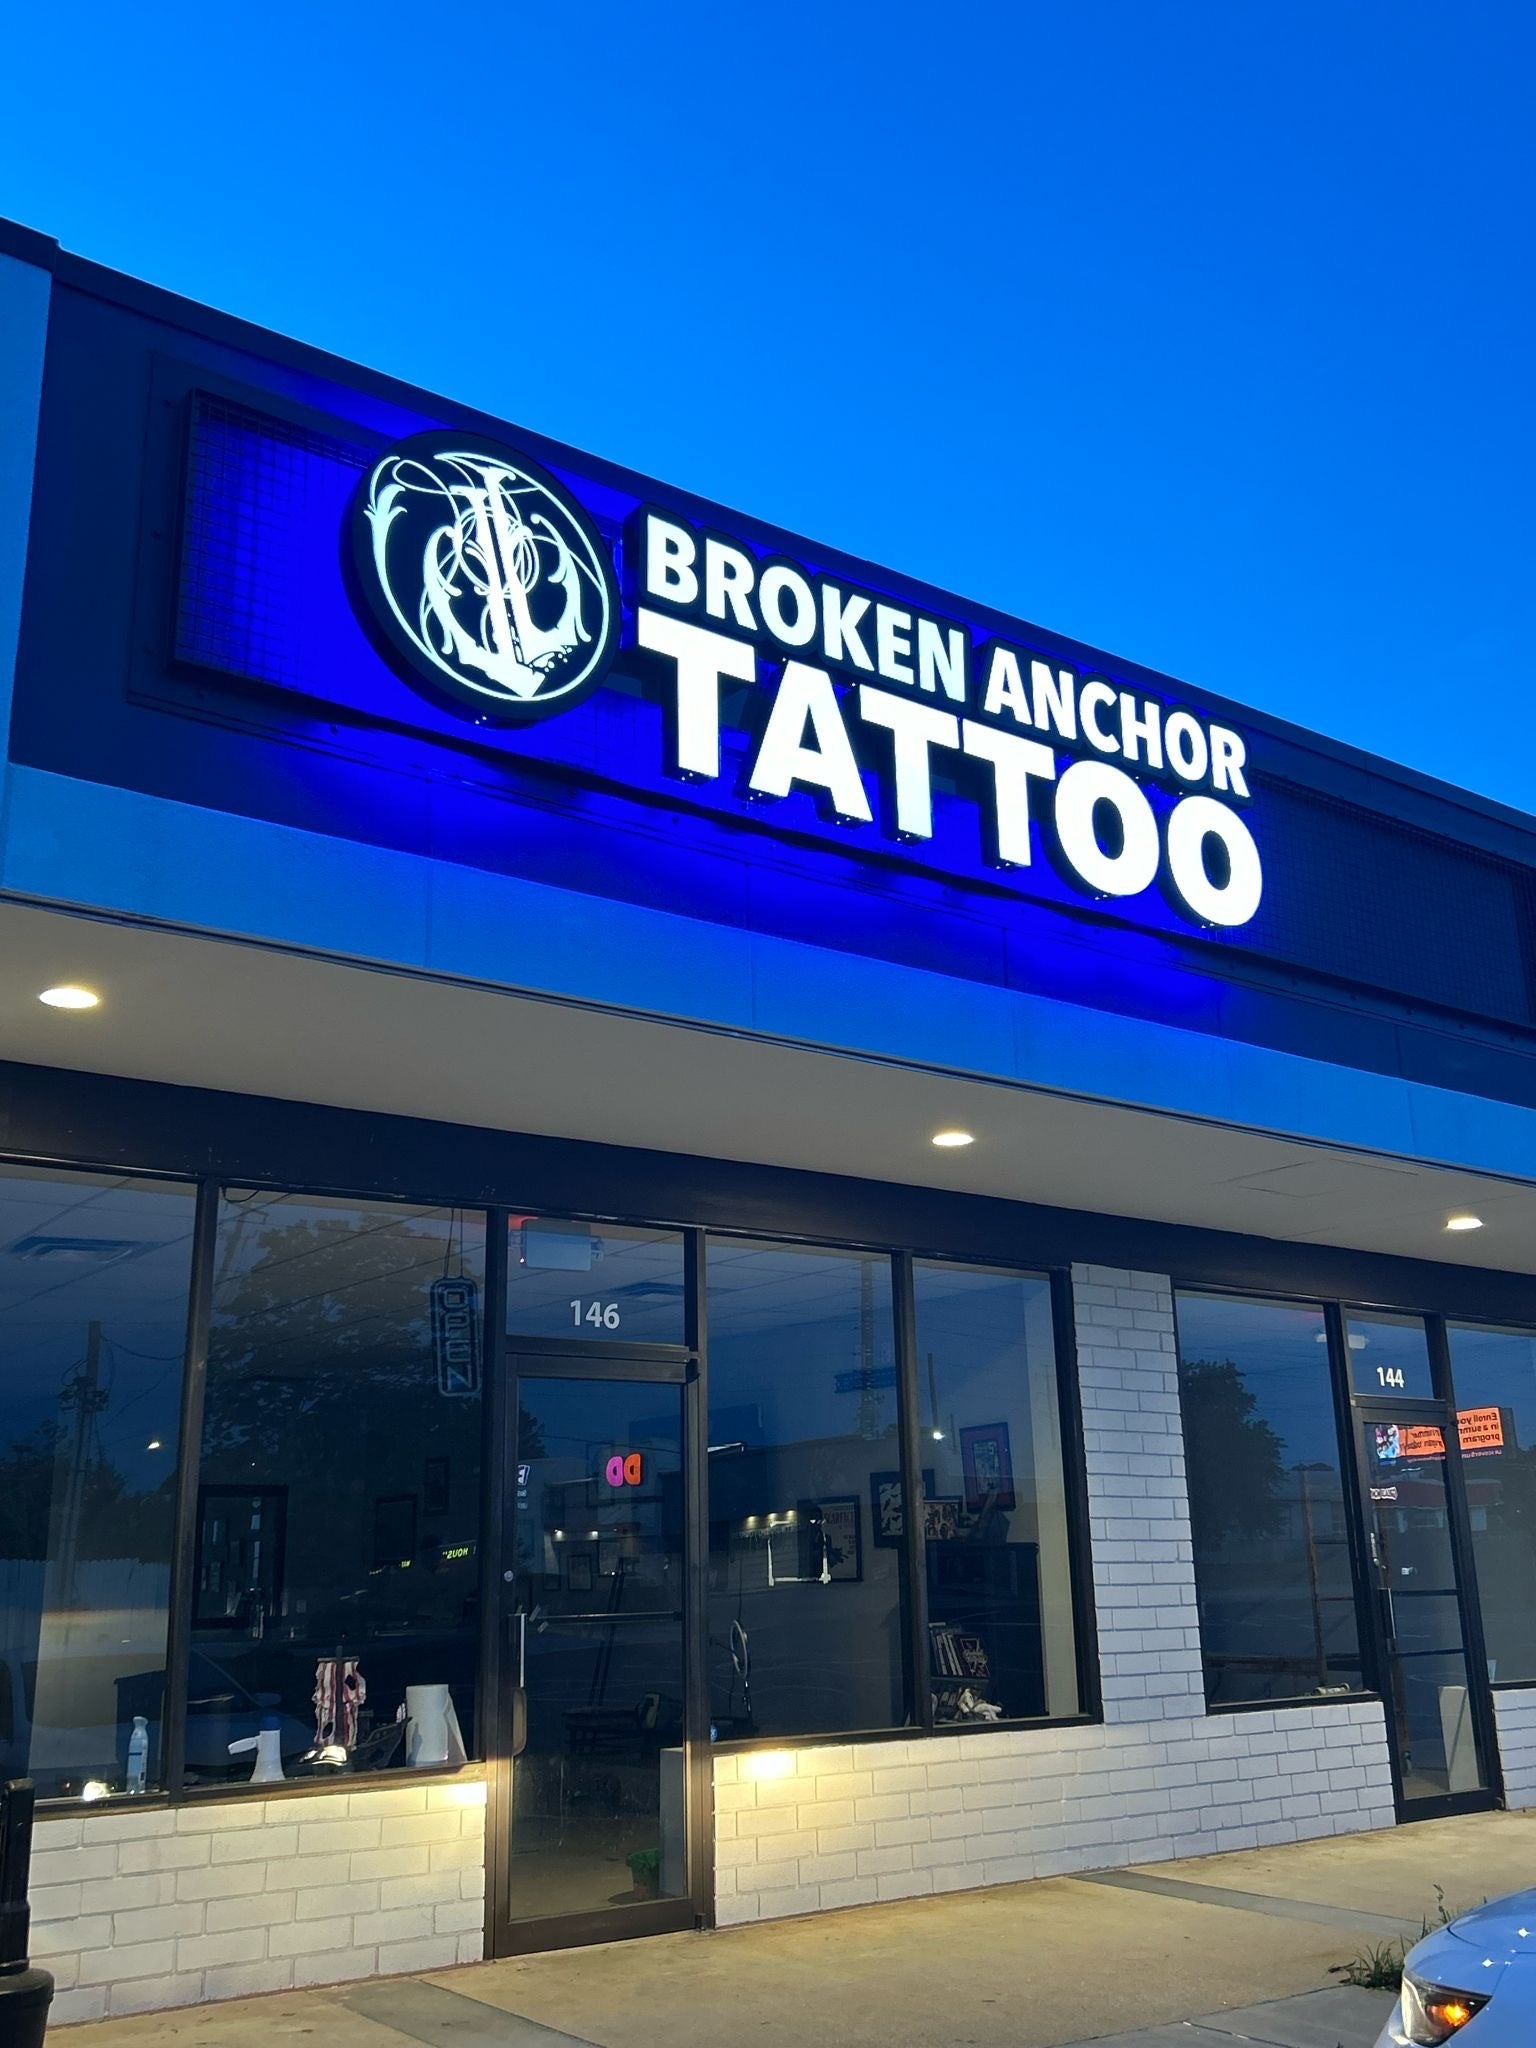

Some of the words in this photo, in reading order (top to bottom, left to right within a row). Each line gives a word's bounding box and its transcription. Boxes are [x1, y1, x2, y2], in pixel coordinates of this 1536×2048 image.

[647, 514, 965, 703] BROKEN
[984, 647, 1250, 798] ANCHOR
[638, 607, 1262, 926] TATTOO
[444, 1287, 472, 1392] OPEN
[570, 1300, 620, 1329] 146
[1376, 1366, 1404, 1388] 144
